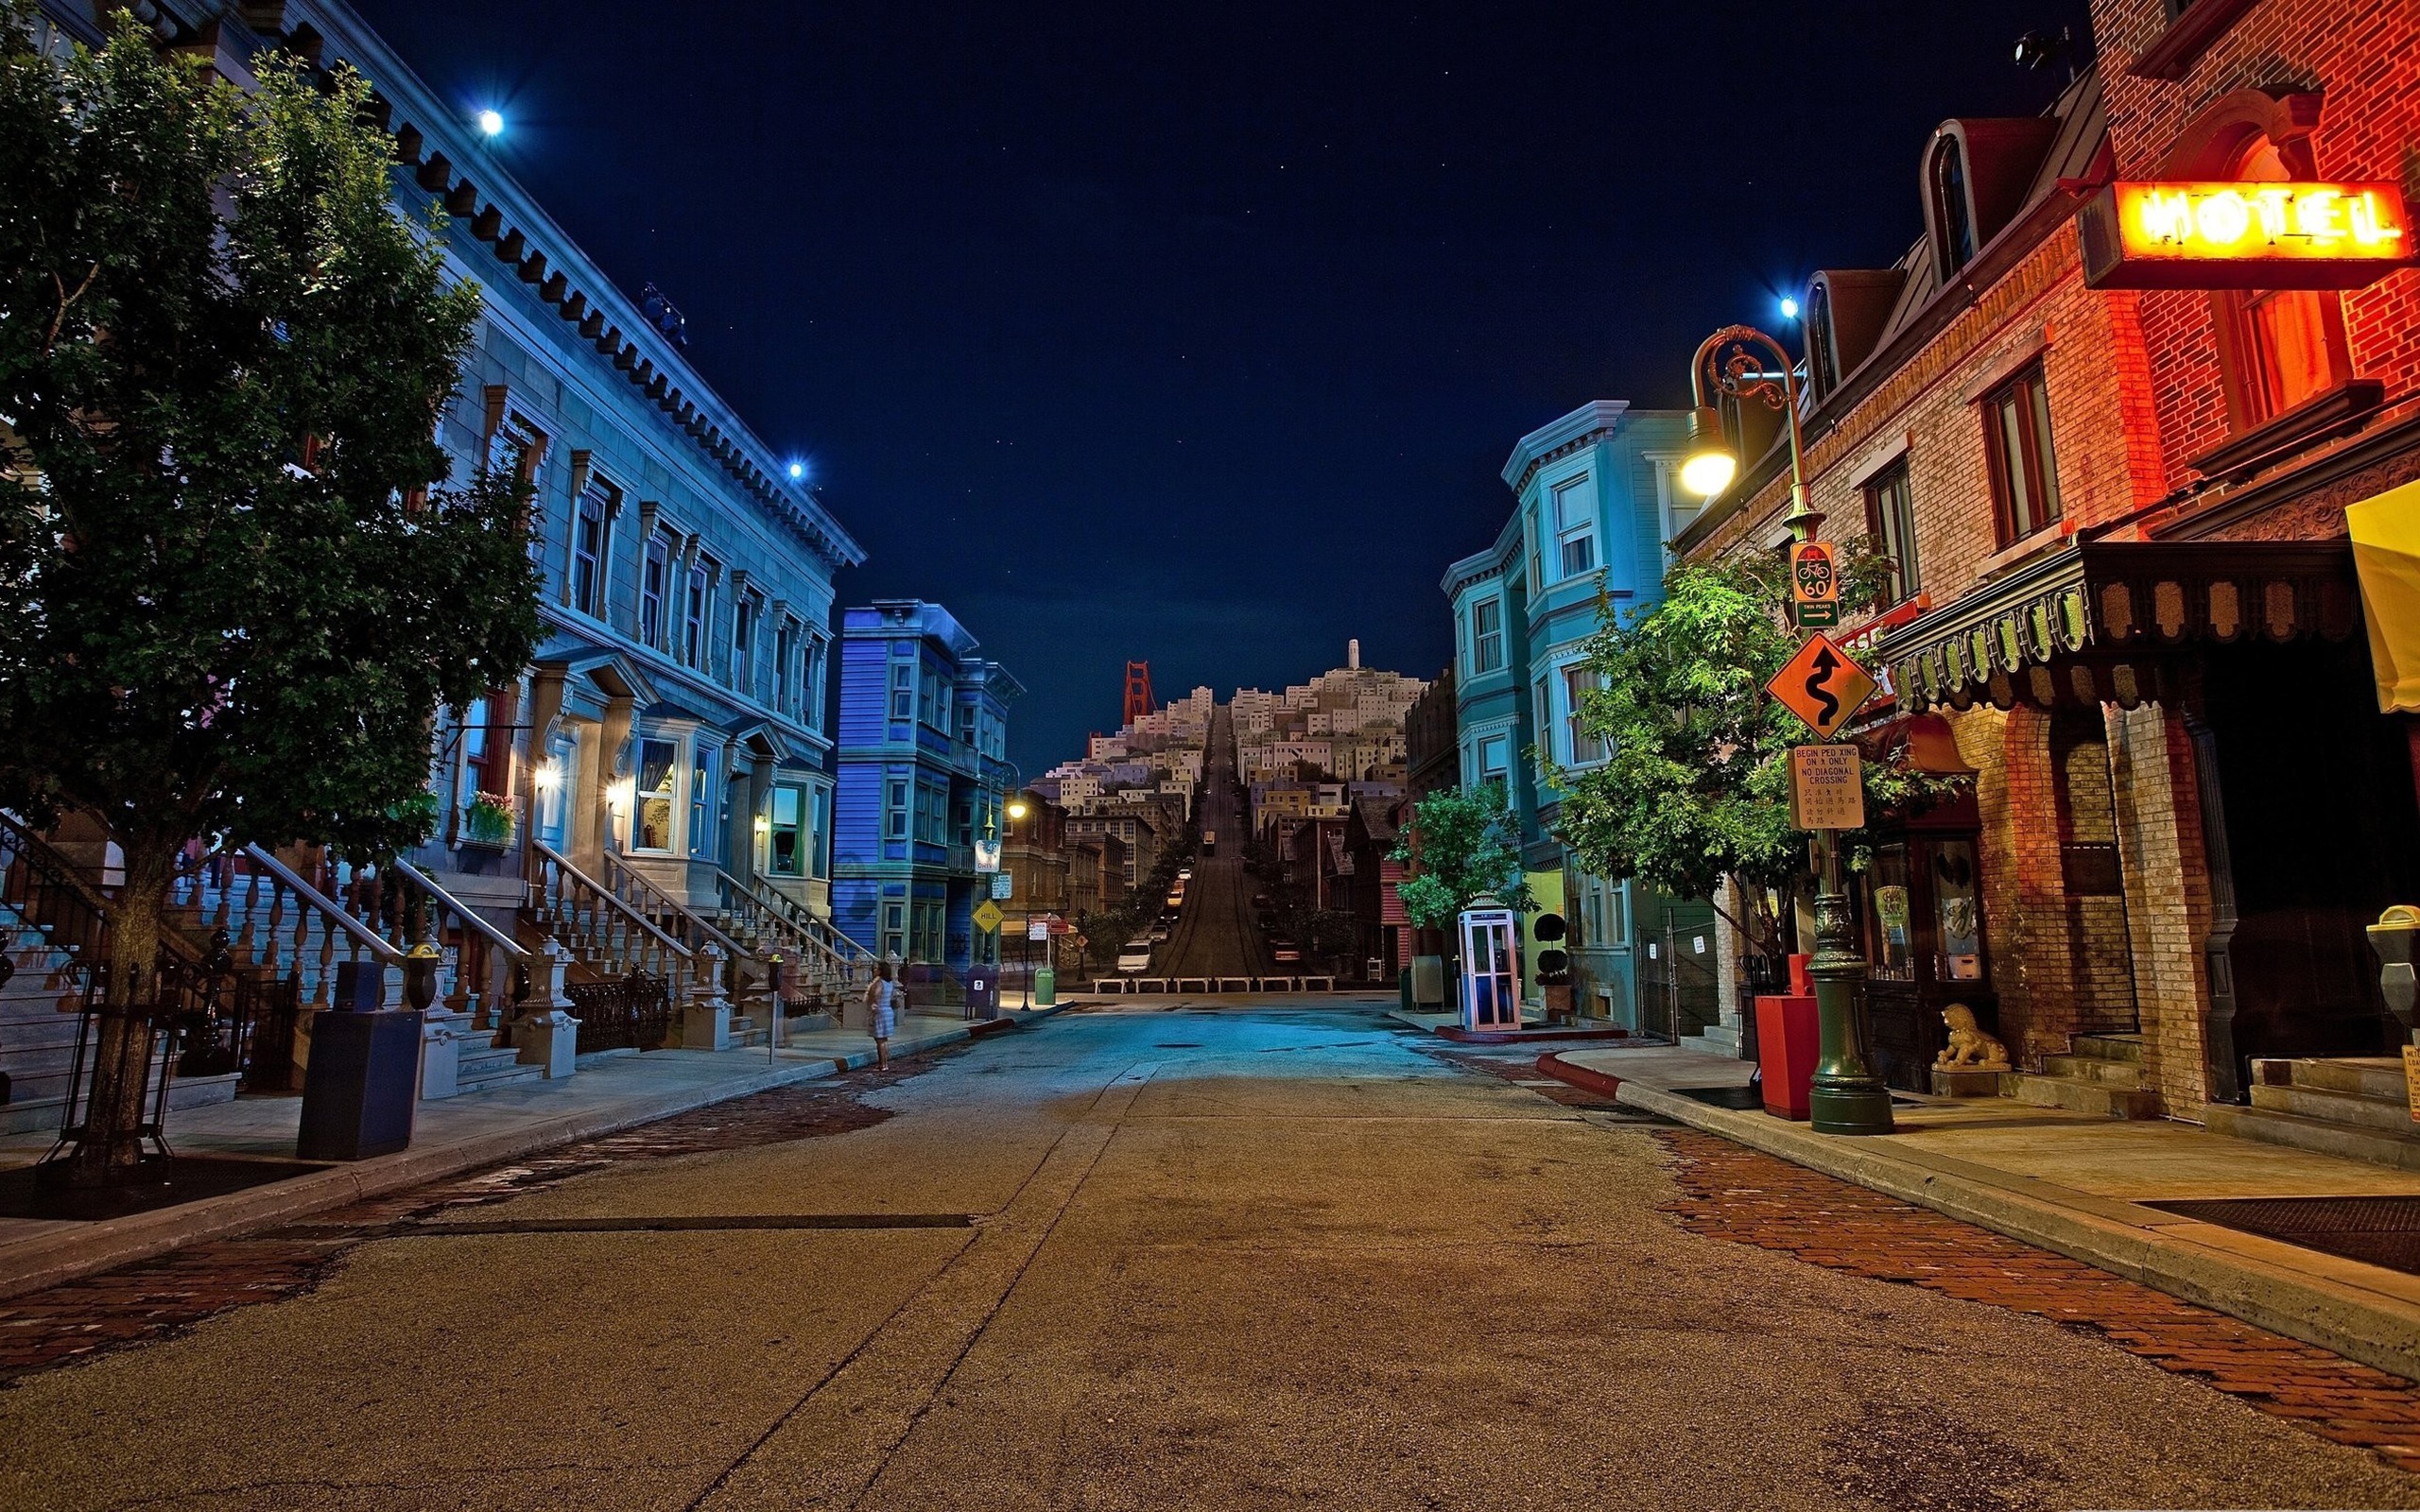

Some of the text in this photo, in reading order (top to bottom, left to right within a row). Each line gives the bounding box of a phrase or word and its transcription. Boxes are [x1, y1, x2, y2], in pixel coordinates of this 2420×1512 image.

[2140, 189, 2403, 245] MOTEL
[1805, 580, 1826, 596] 60
[1822, 748, 1836, 757] PED
[1806, 757, 1847, 766] ON ONLY
[1815, 767, 1855, 776] DIAGONAL
[1809, 776, 1848, 784] CROSSING
[987, 843, 998, 851] 49
